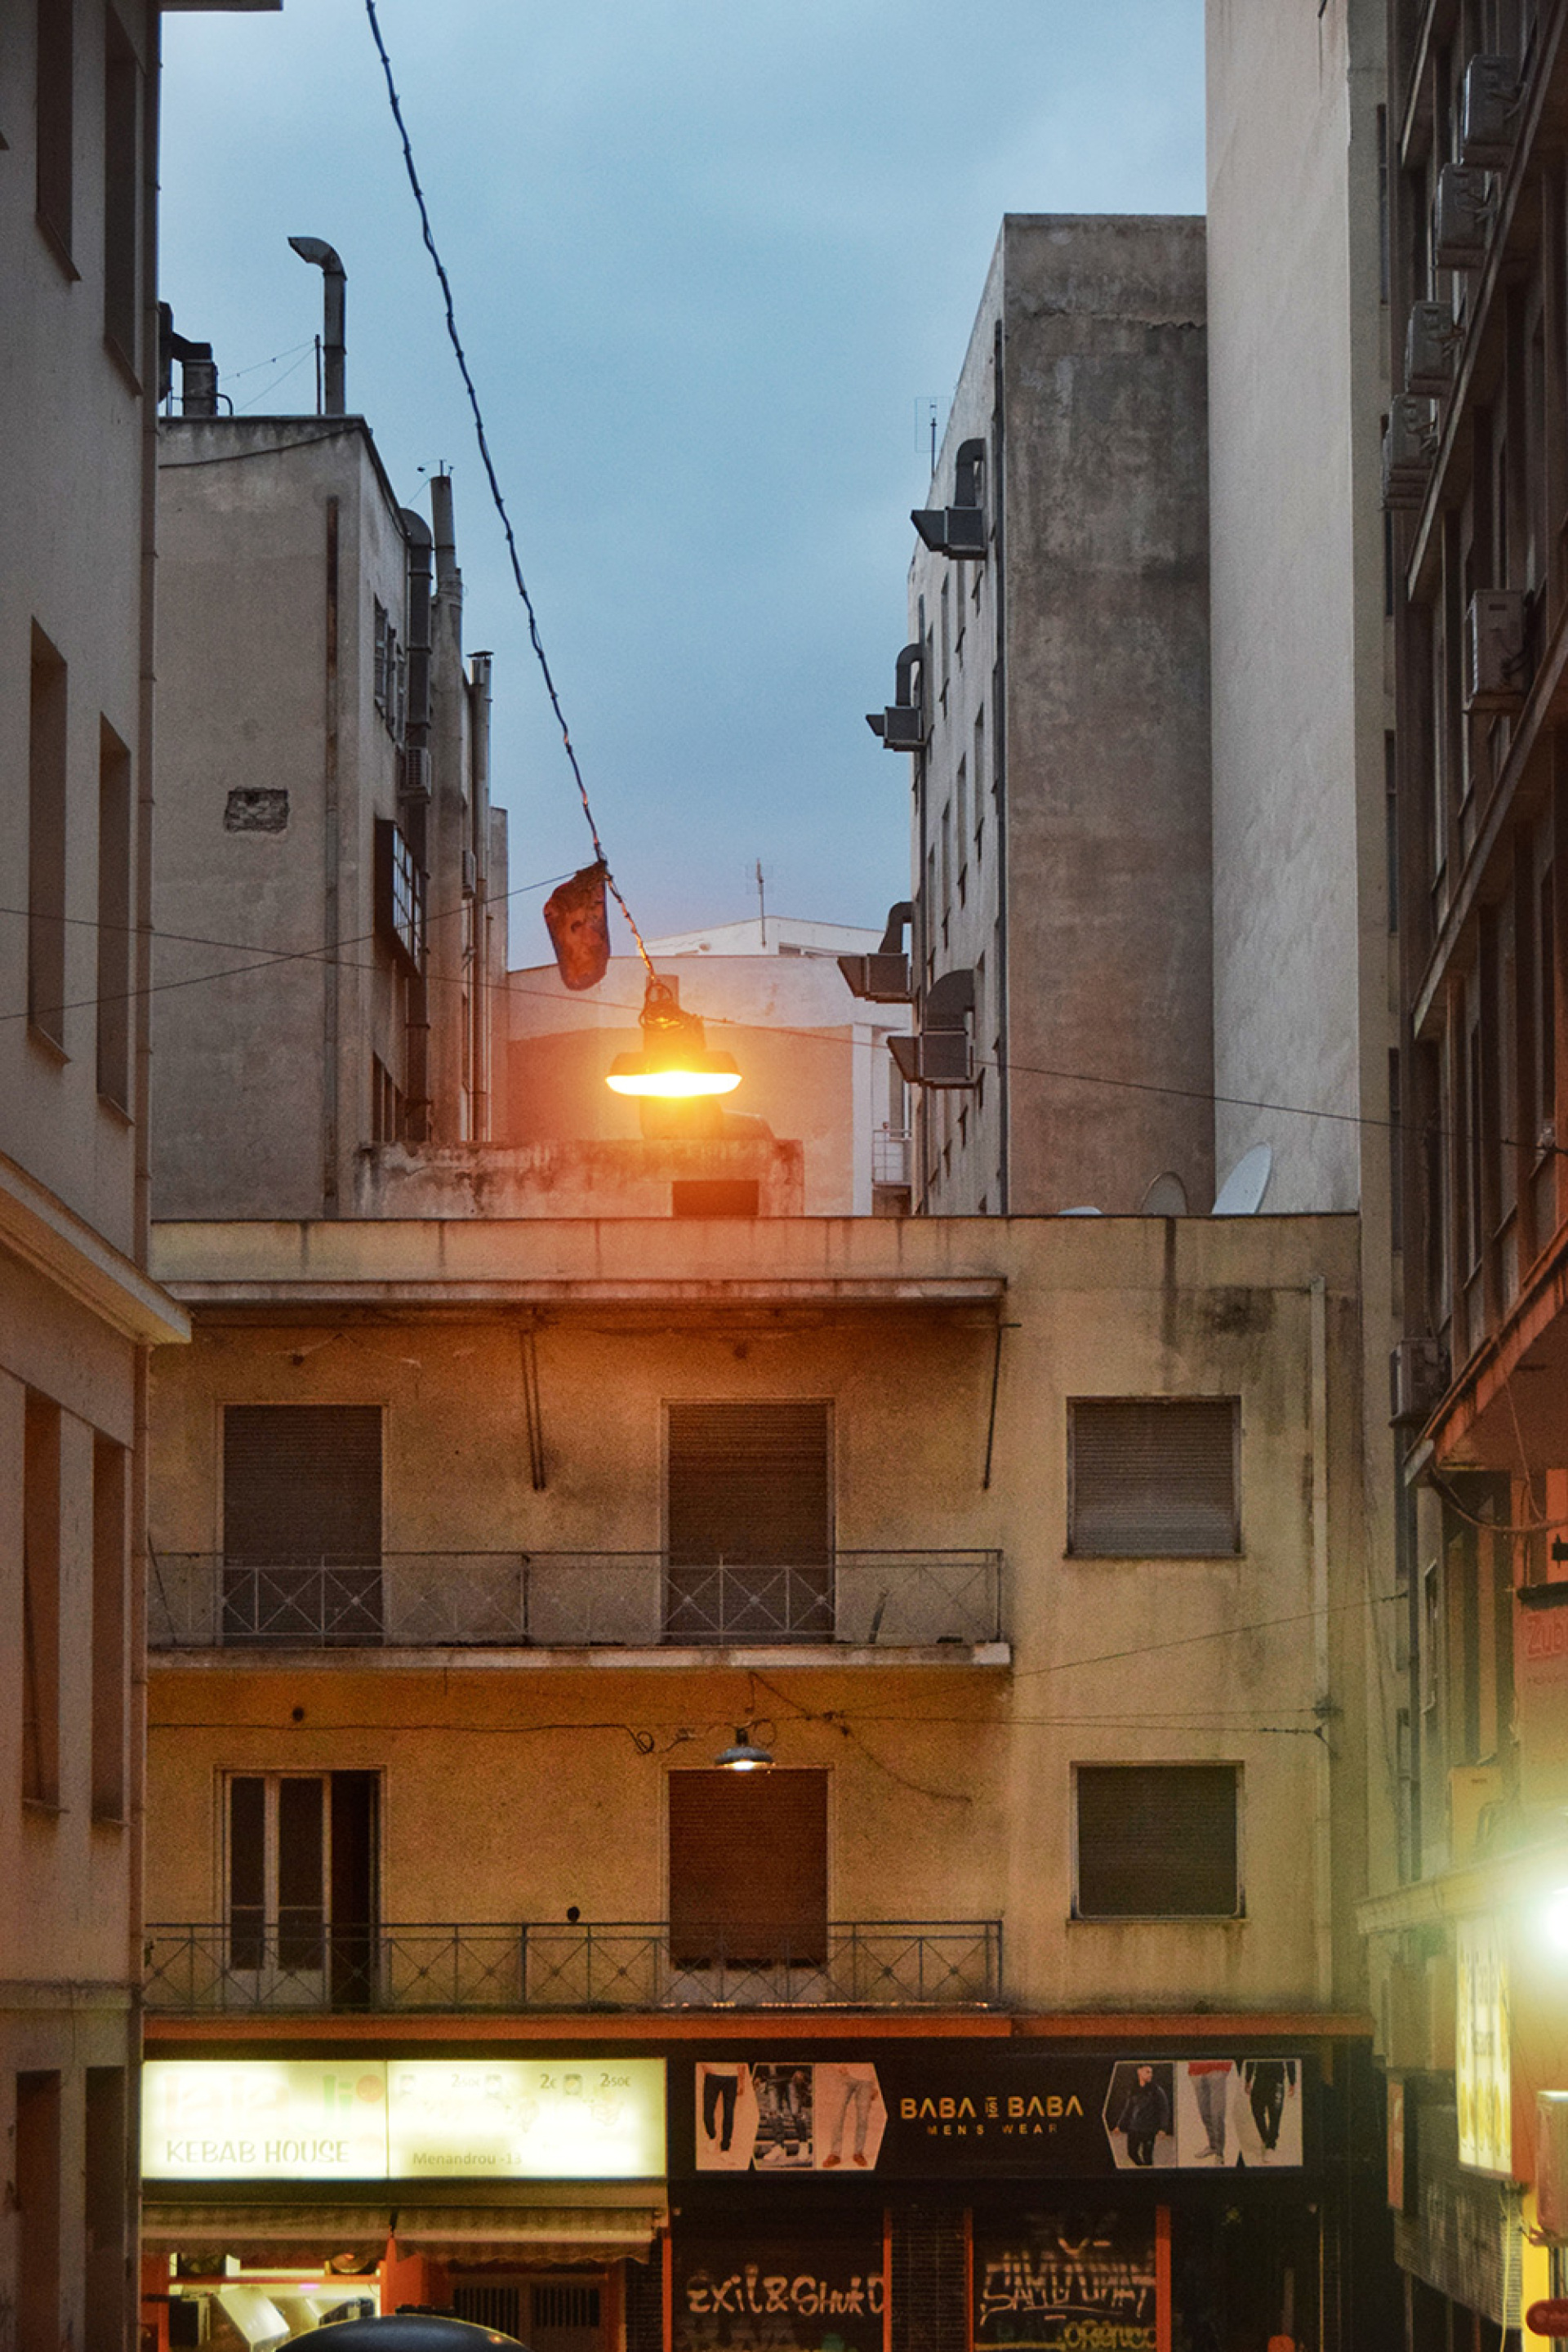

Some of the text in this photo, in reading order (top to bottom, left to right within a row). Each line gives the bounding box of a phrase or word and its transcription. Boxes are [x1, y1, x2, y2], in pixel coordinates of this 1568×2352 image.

[1526, 1610, 1568, 1655] Zub
[901, 2097, 978, 2119] BABA
[1007, 2095, 1085, 2118] BABA
[927, 2123, 1058, 2136] MENS WEAR
[166, 2140, 350, 2163] KEBAB HOUSE
[412, 2152, 497, 2165] Menandrou
